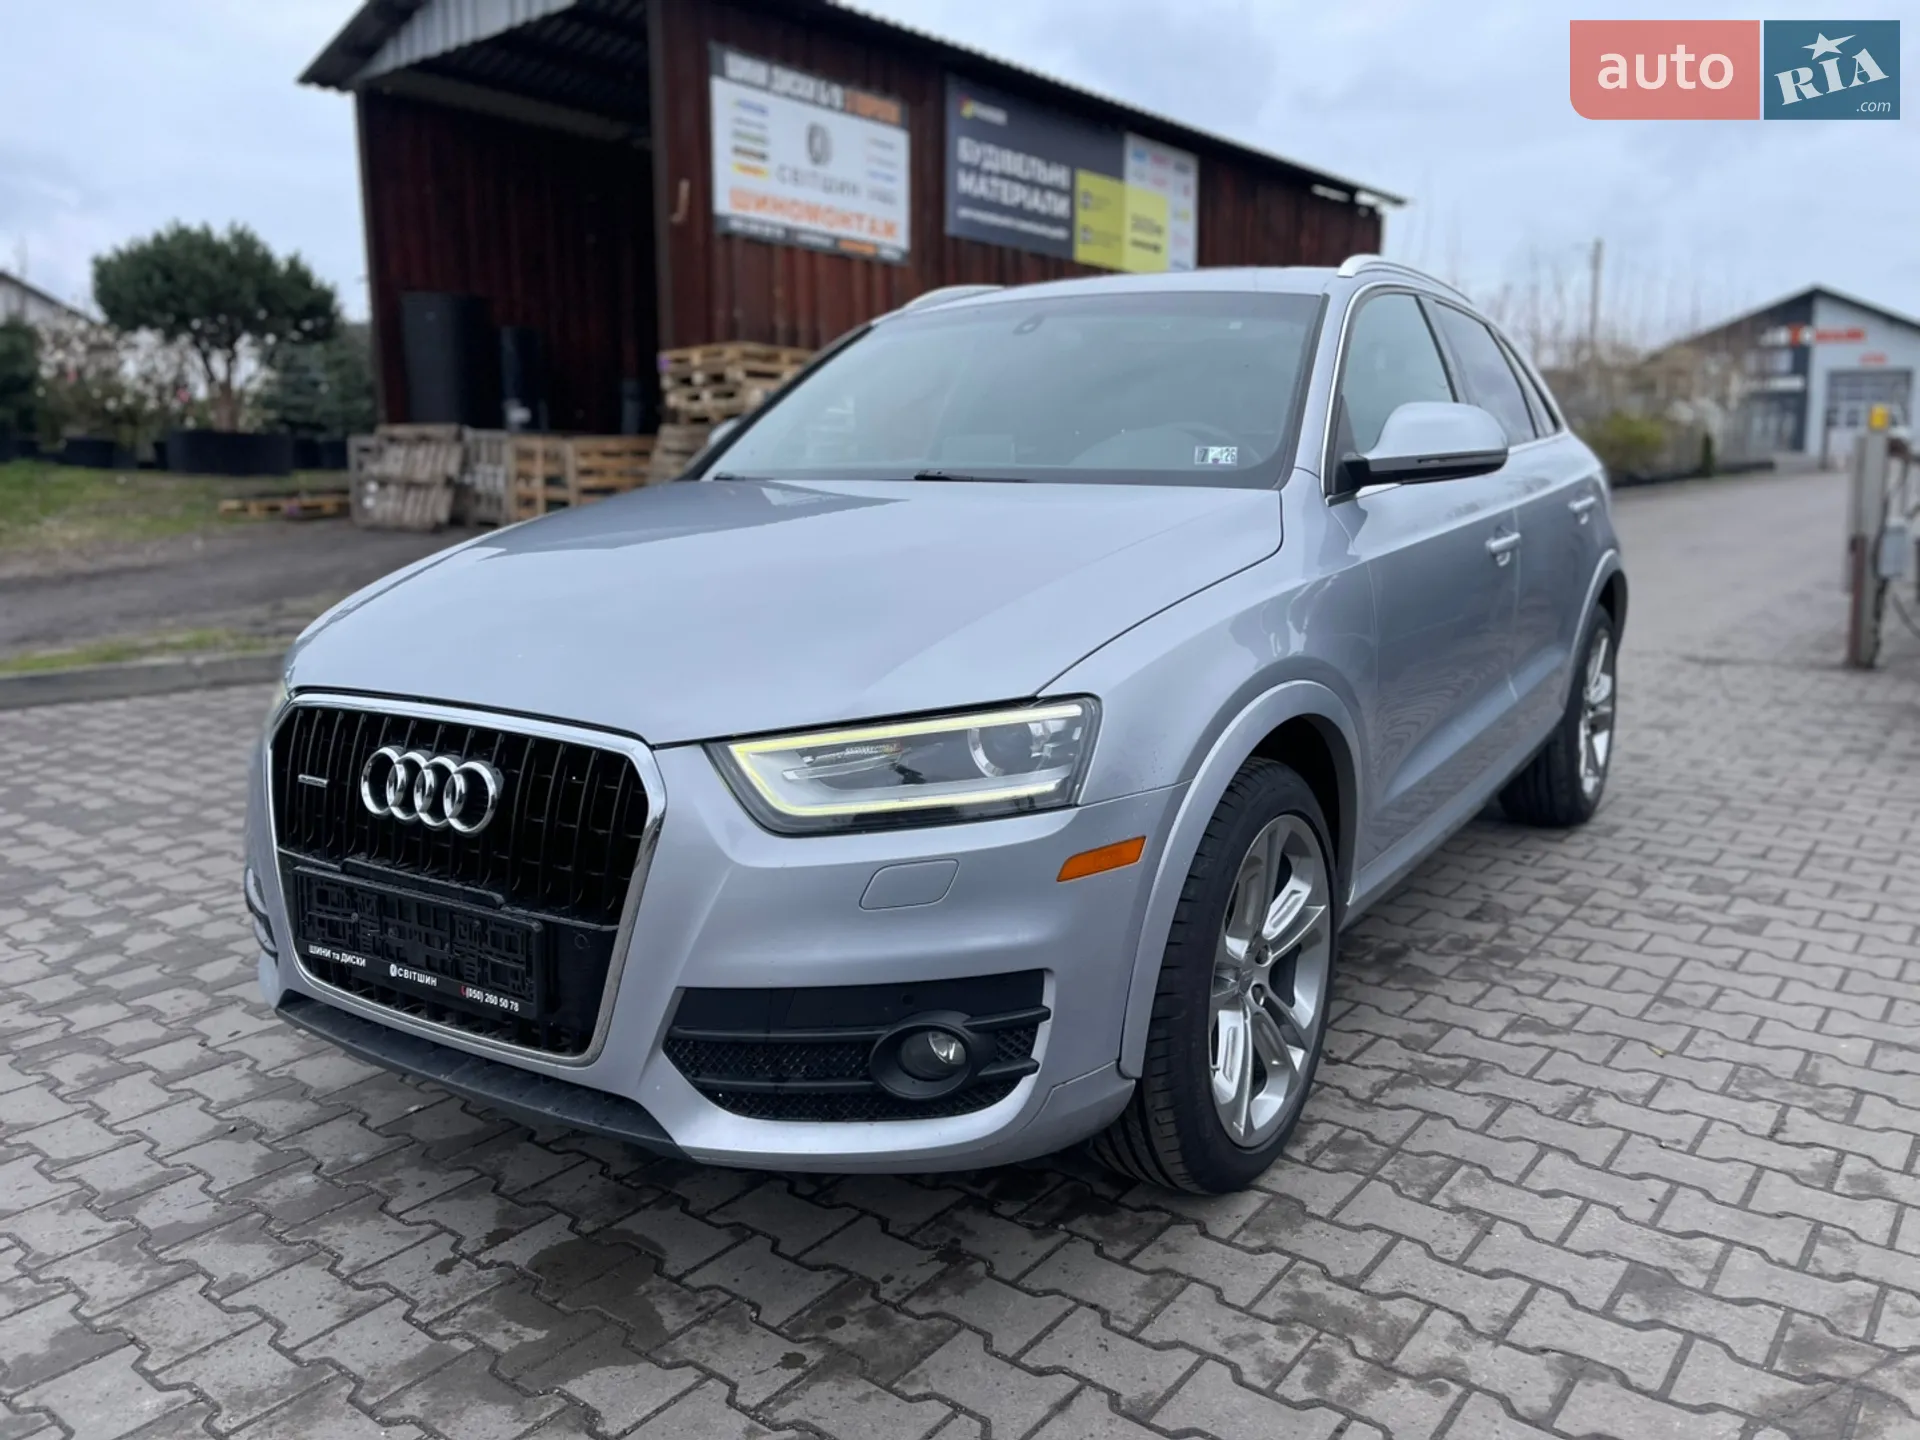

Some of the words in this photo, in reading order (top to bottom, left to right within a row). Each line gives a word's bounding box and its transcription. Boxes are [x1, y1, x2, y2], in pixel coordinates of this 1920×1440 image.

[956, 169, 1071, 218] МАТЕРІАЛИ
[308, 944, 332, 958] ШИНИ
[331, 952, 341, 961] та
[340, 952, 367, 967] ДИСКИ
[397, 968, 438, 987] СВІТШИН
[465, 987, 484, 1003] (050)
[484, 993, 499, 1006] 260
[499, 997, 509, 1010] 50
[509, 1000, 520, 1013] 78
